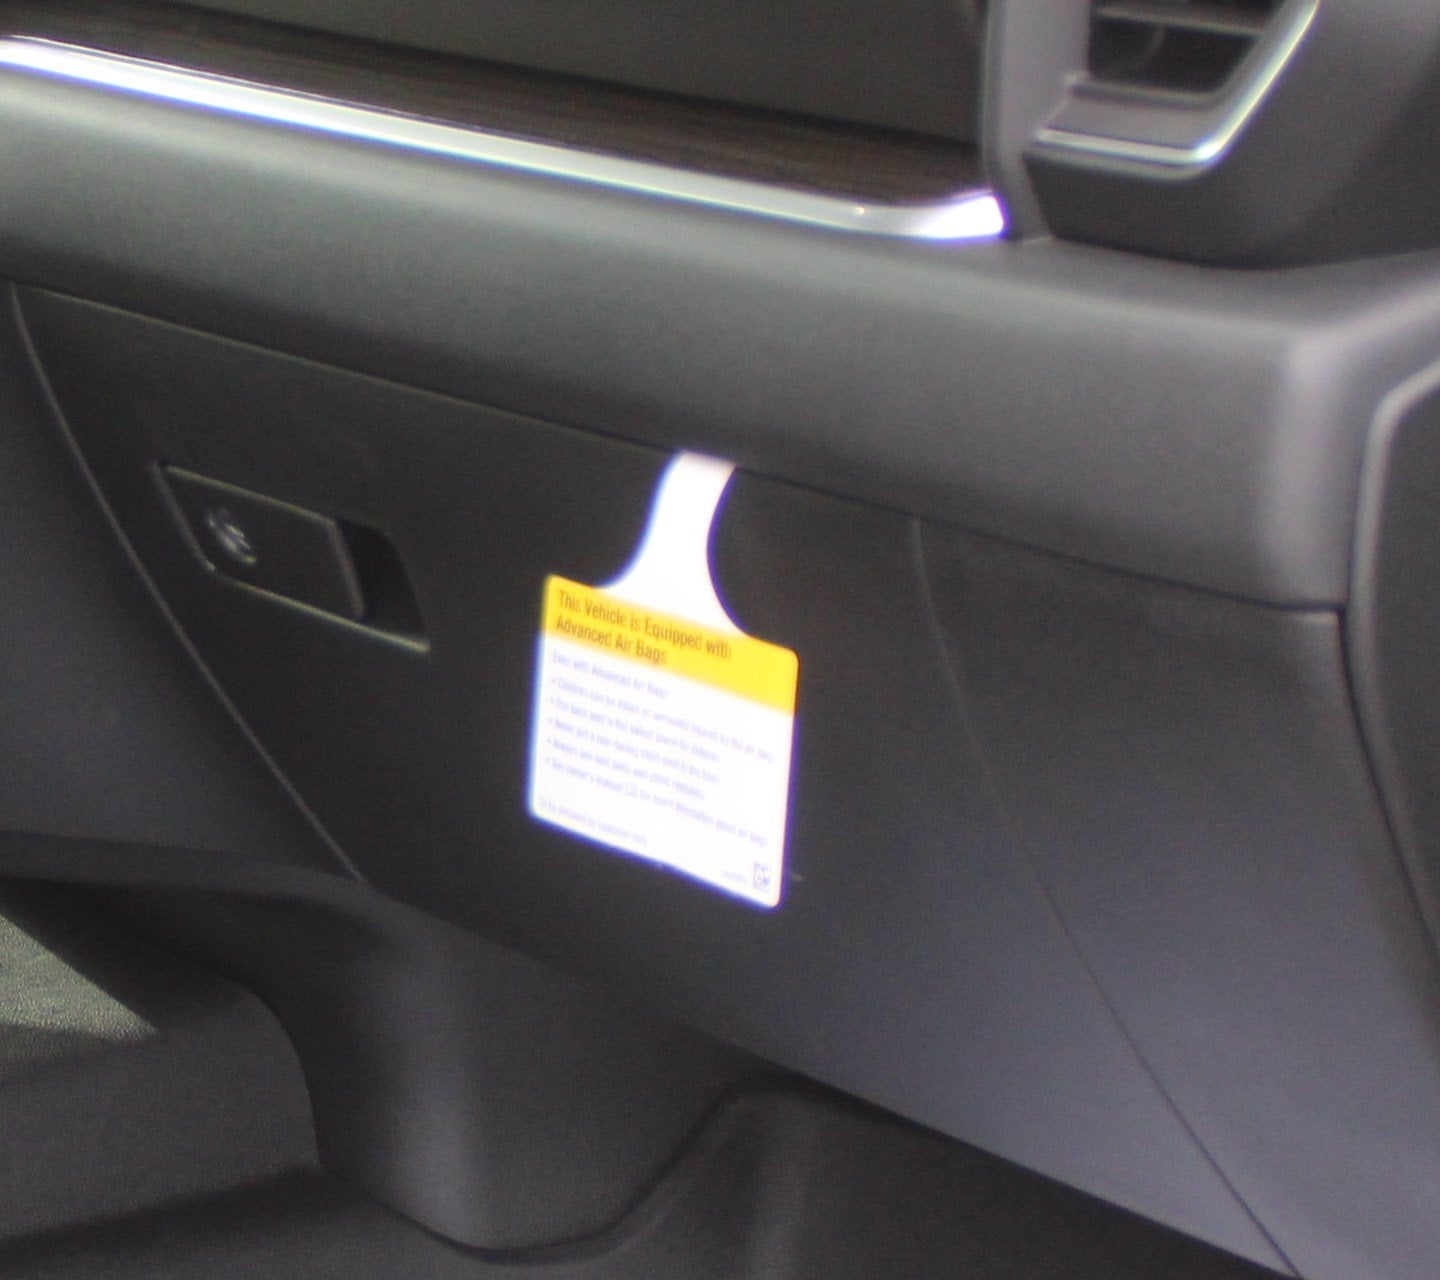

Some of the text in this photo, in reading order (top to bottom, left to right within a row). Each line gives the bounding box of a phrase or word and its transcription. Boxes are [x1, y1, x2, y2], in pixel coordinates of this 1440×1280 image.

[556, 614, 668, 664] Advanced Air Bags
[559, 589, 732, 660] This Vehicle is Equipped with
